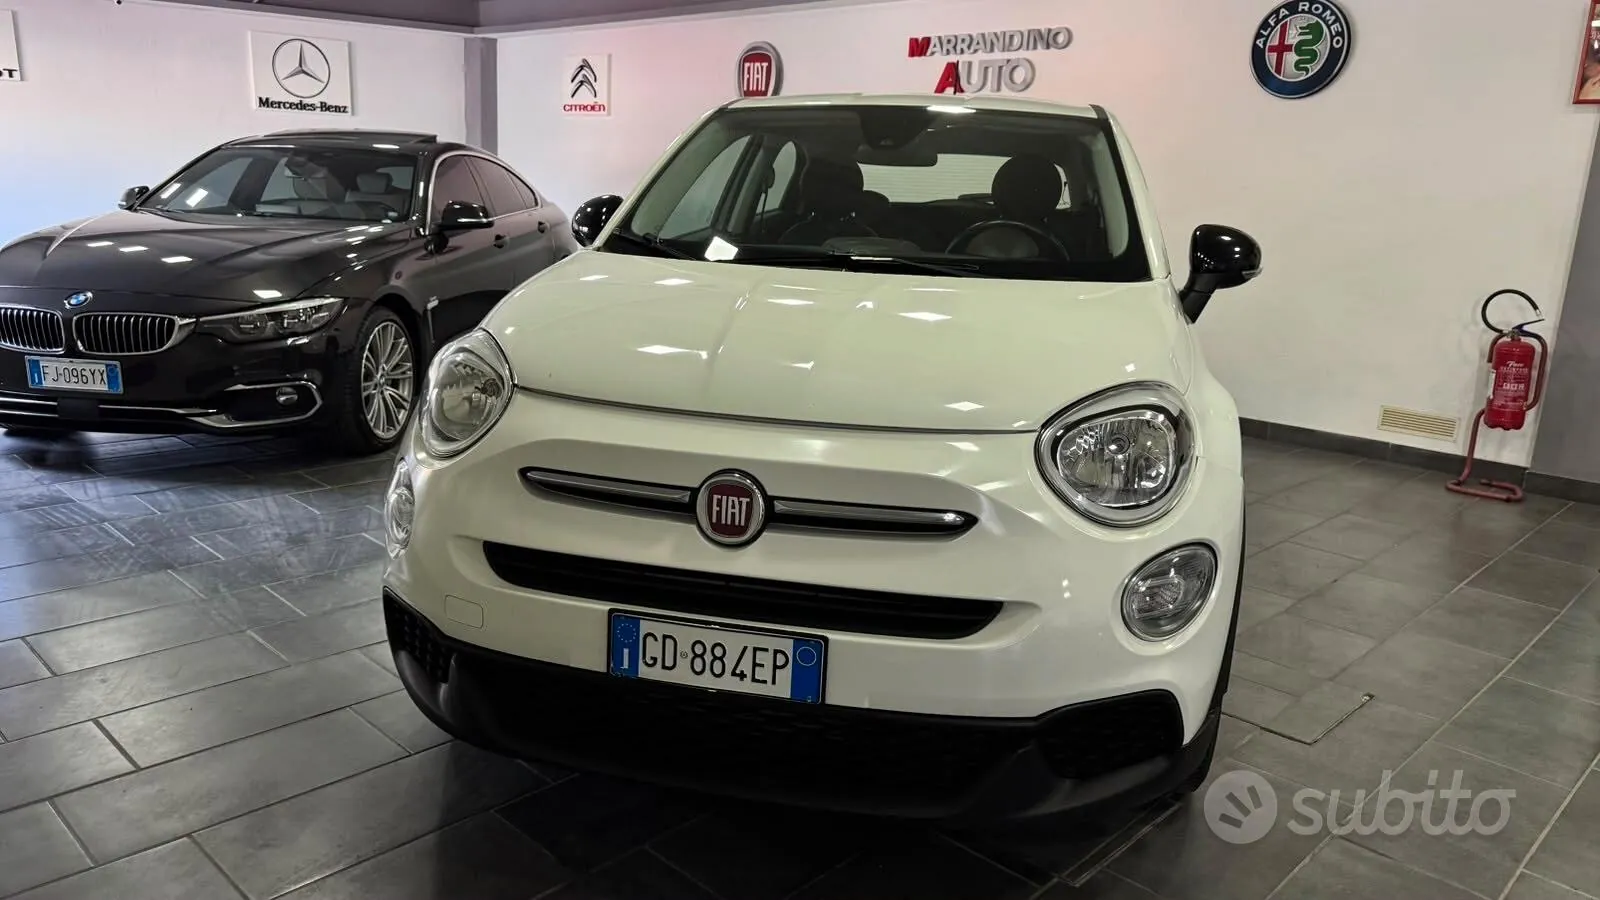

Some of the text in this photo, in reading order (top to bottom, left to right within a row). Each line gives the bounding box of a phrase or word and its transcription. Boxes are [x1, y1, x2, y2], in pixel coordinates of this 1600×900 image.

[1256, 2, 1343, 48] ALFA ROMEO
[908, 26, 1073, 57] MARRANDINO
[743, 62, 768, 91] FIAT
[934, 57, 1036, 94] AUTO
[257, 96, 349, 114] Mercedes-Benz
[712, 494, 750, 527] FIAT
